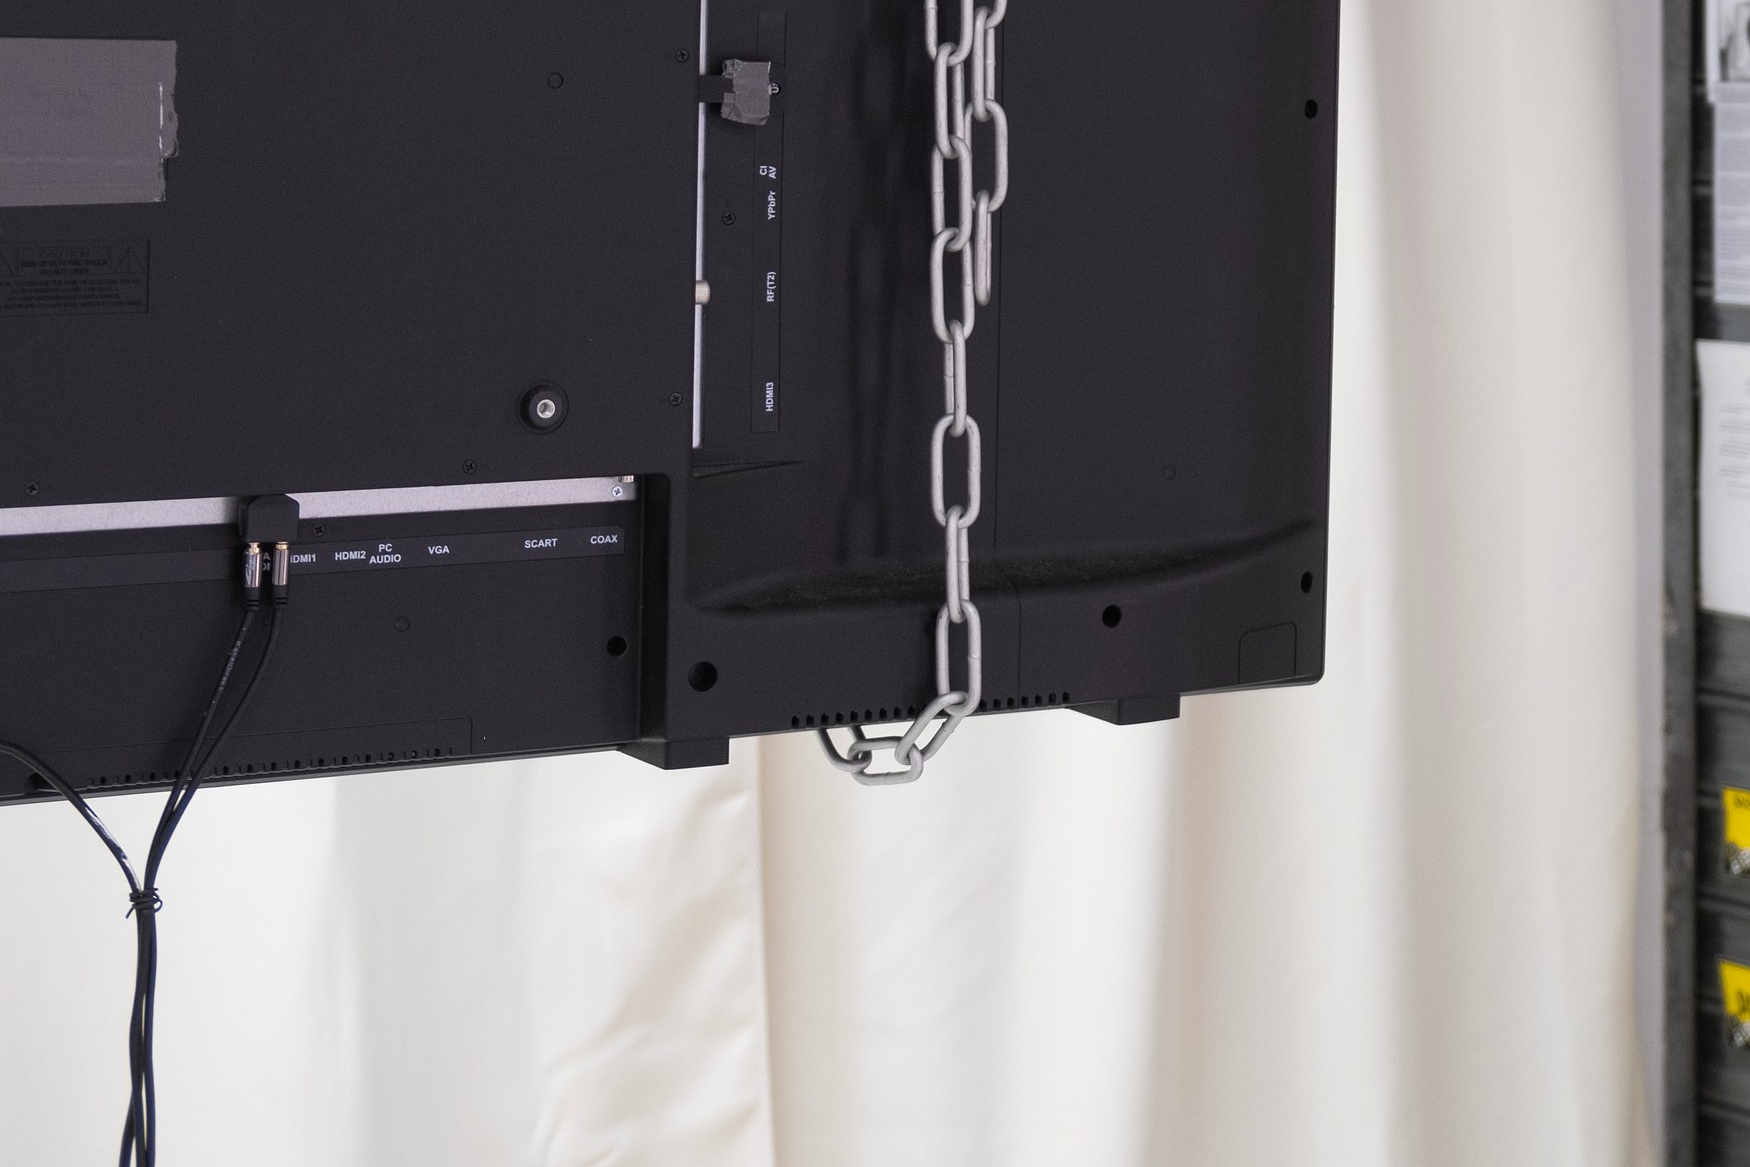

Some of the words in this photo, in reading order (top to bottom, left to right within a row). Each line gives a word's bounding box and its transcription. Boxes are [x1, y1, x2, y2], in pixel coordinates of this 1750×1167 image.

[768, 166, 777, 179] AV
[767, 190, 776, 220] YPbPr
[767, 271, 776, 302] RF(T2)
[765, 382, 774, 412] HDMI3
[378, 543, 393, 553] PC
[524, 538, 558, 549] SCART
[590, 535, 618, 545] COAX
[289, 553, 316, 564] DMI1
[335, 550, 366, 562] HDMI2
[428, 545, 450, 555] VGA
[369, 553, 401, 564] AUDIO
